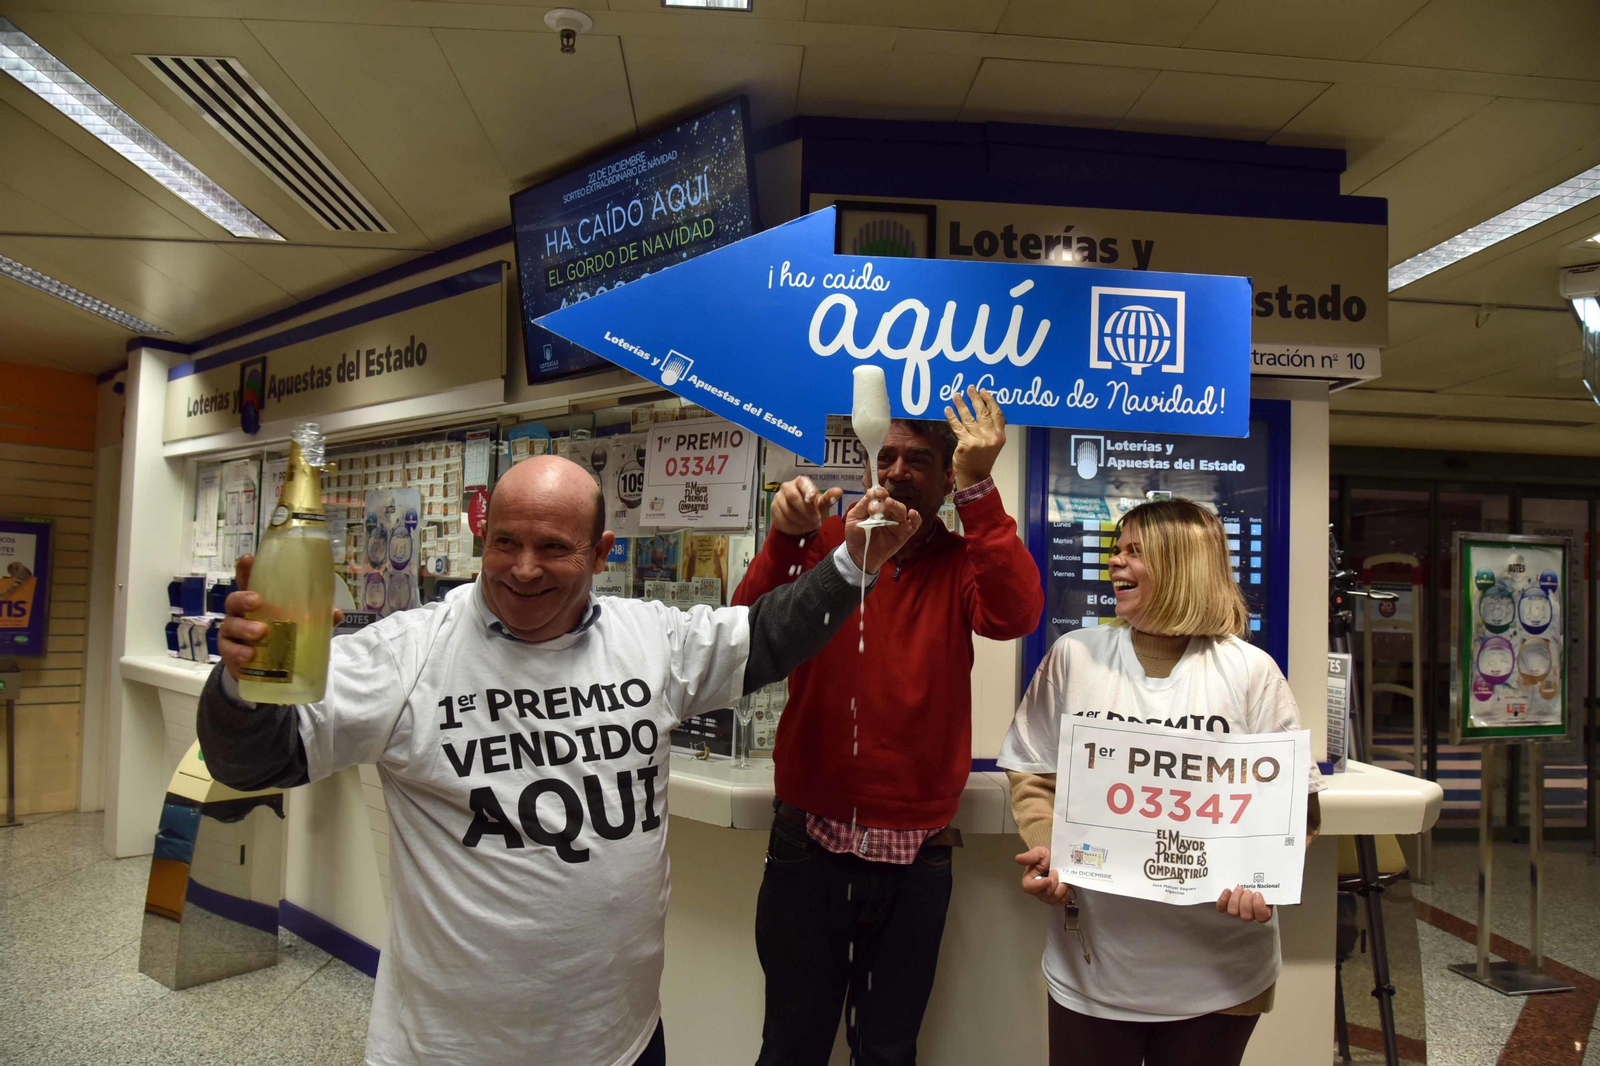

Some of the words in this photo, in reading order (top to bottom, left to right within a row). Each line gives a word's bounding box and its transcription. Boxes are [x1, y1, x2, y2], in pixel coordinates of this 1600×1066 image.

[562, 186, 586, 204] SORTEO
[585, 168, 638, 195] EXTRAORDINARIO
[638, 161, 648, 175] DE
[647, 150, 678, 169] NAVIDAD
[588, 171, 598, 185] 22
[597, 167, 608, 180] DE
[607, 151, 647, 177] DICIEMBRE
[545, 226, 574, 257] HA
[577, 200, 645, 245] CAÍDO
[651, 165, 710, 220] AQUÍ
[548, 268, 564, 288] EL
[566, 250, 615, 281] GORDO
[619, 242, 639, 265] DE
[642, 217, 715, 257] NAVIDAD
[949, 220, 1119, 264] Loterías
[1131, 239, 1155, 271] y
[1251, 283, 1367, 323] stado
[603, 330, 651, 361] Loterías
[650, 356, 662, 367] y
[808, 279, 1051, 416] aquí
[1346, 352, 1366, 371] 10
[267, 363, 332, 403] Apuestas
[336, 349, 361, 384] del
[365, 335, 428, 378] Estado
[187, 388, 230, 418] Loterías
[232, 389, 241, 415] y
[686, 374, 741, 407] Apuestas
[742, 402, 763, 418] del
[762, 411, 804, 438] Estado
[939, 372, 965, 402] el
[1066, 378, 1099, 409] de
[1106, 380, 1226, 415] Navidad!
[675, 429, 744, 451] PREMIO
[1106, 439, 1163, 453] Loterías
[1165, 442, 1175, 456] y
[665, 454, 730, 477] 03347
[1106, 456, 1170, 471] Apuestas
[1173, 458, 1195, 470] del
[1199, 459, 1246, 472] Estado
[1053, 553, 1081, 561] Miércoles
[1053, 570, 1076, 578] Viernes
[1087, 594, 1098, 605] El
[1051, 618, 1080, 626] Domingo
[438, 692, 477, 731] 1er
[485, 678, 652, 723] PREMIO
[1072, 710, 1101, 719] er
[441, 718, 659, 778] VENDIDO
[1084, 742, 1116, 770] 1er
[1127, 746, 1281, 784] PREMIO
[461, 756, 661, 864] AQUÍ
[1106, 782, 1253, 825] 03347
[1156, 829, 1168, 840] EL
[1154, 841, 1194, 865] PREMIO
[1078, 869, 1113, 880] DICIEMBRE
[1143, 858, 1209, 885] COMPARTIRLO
